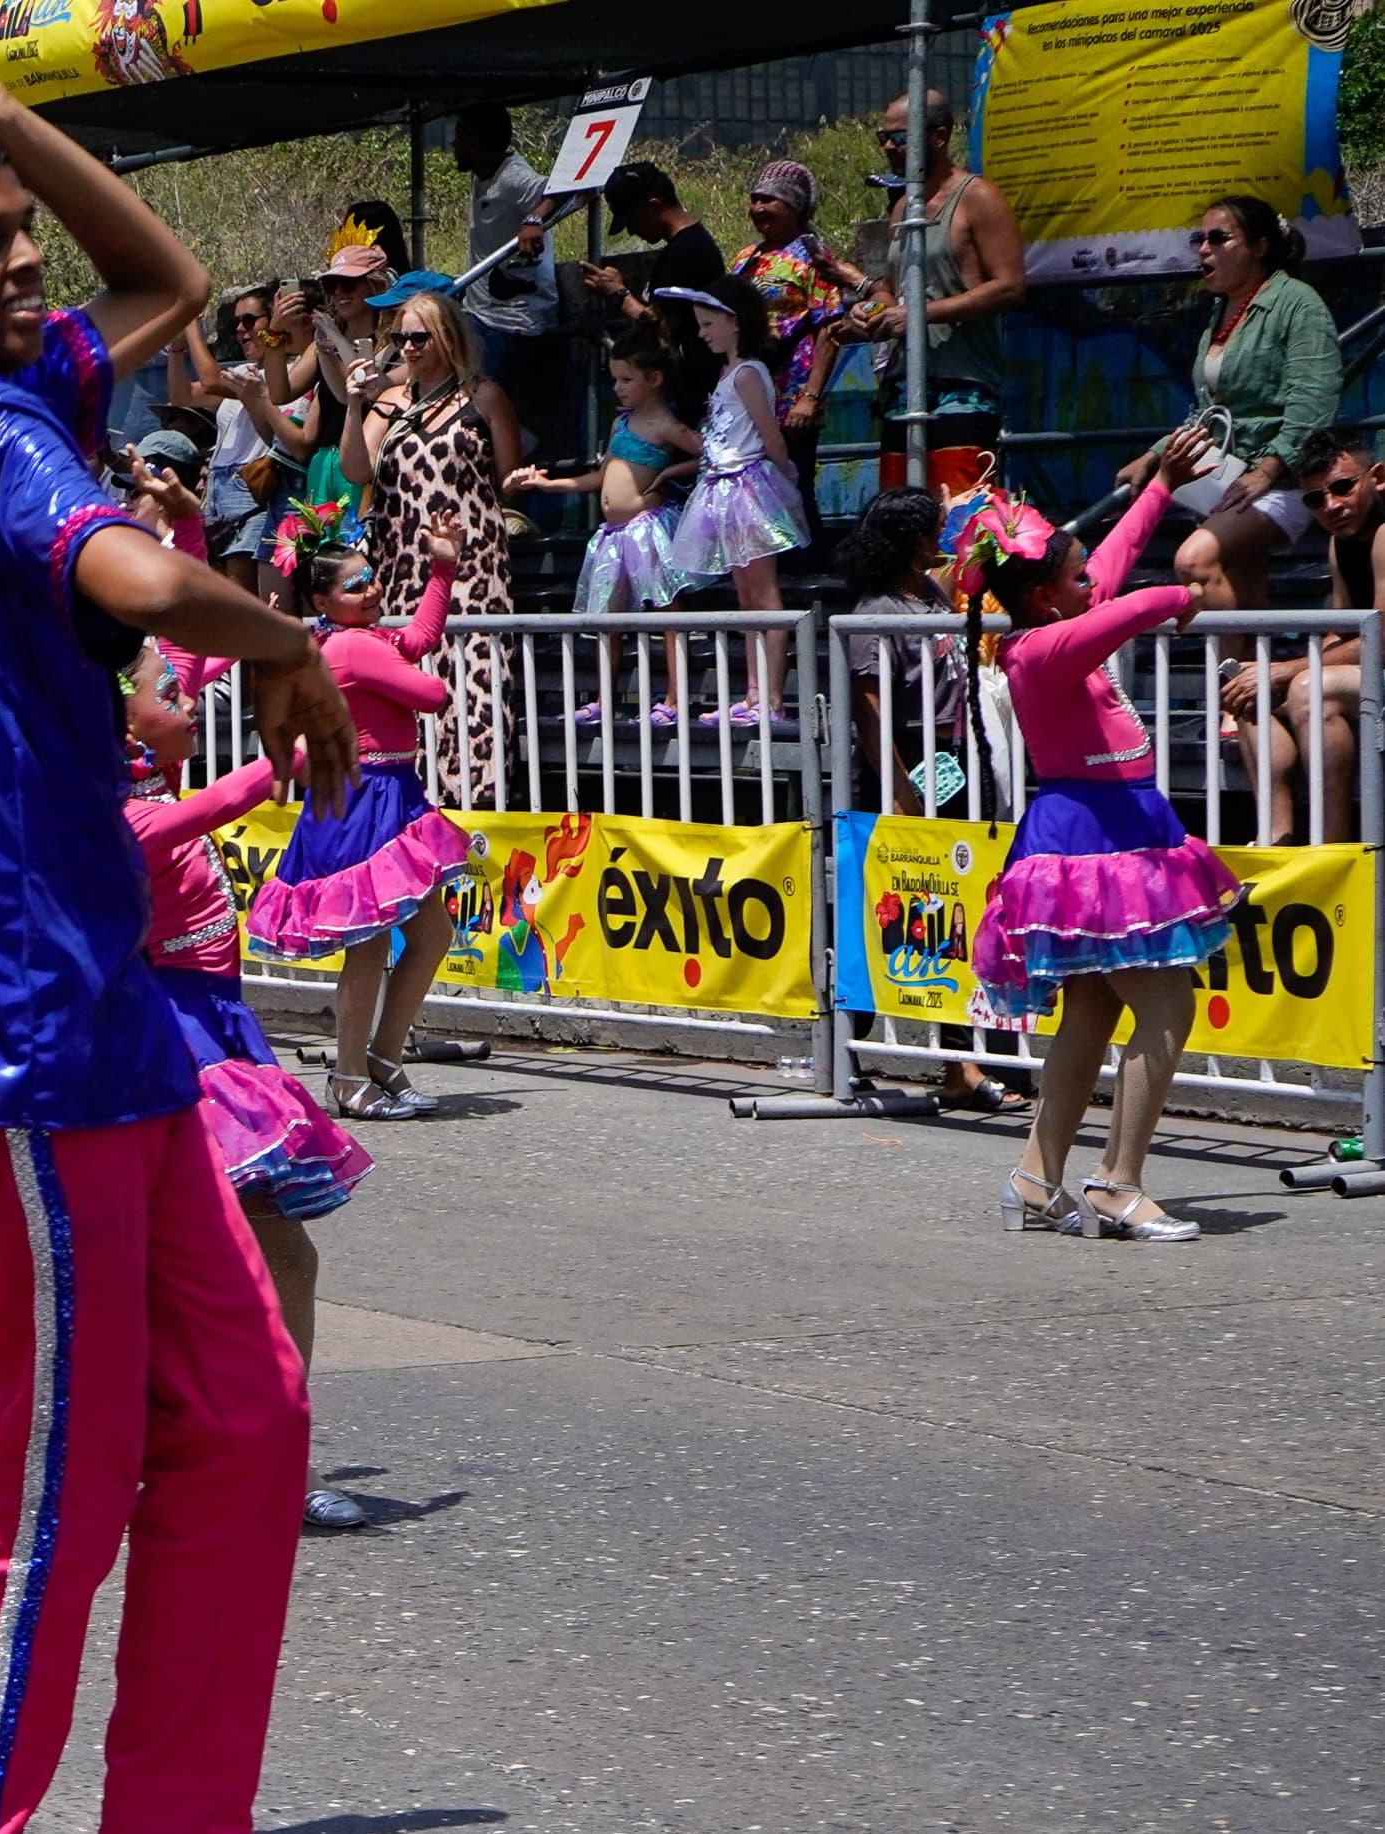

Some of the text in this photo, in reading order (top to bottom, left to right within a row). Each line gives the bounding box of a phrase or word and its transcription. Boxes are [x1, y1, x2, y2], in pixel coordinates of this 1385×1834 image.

[1028, 0, 1255, 35] Recomendaciones para una mejor experiencia
[1043, 21, 1221, 50] en los minipalcos del carnaval 2025
[580, 85, 629, 106] MINIPALCO
[574, 119, 617, 181] 7
[598, 846, 786, 988] éxito
